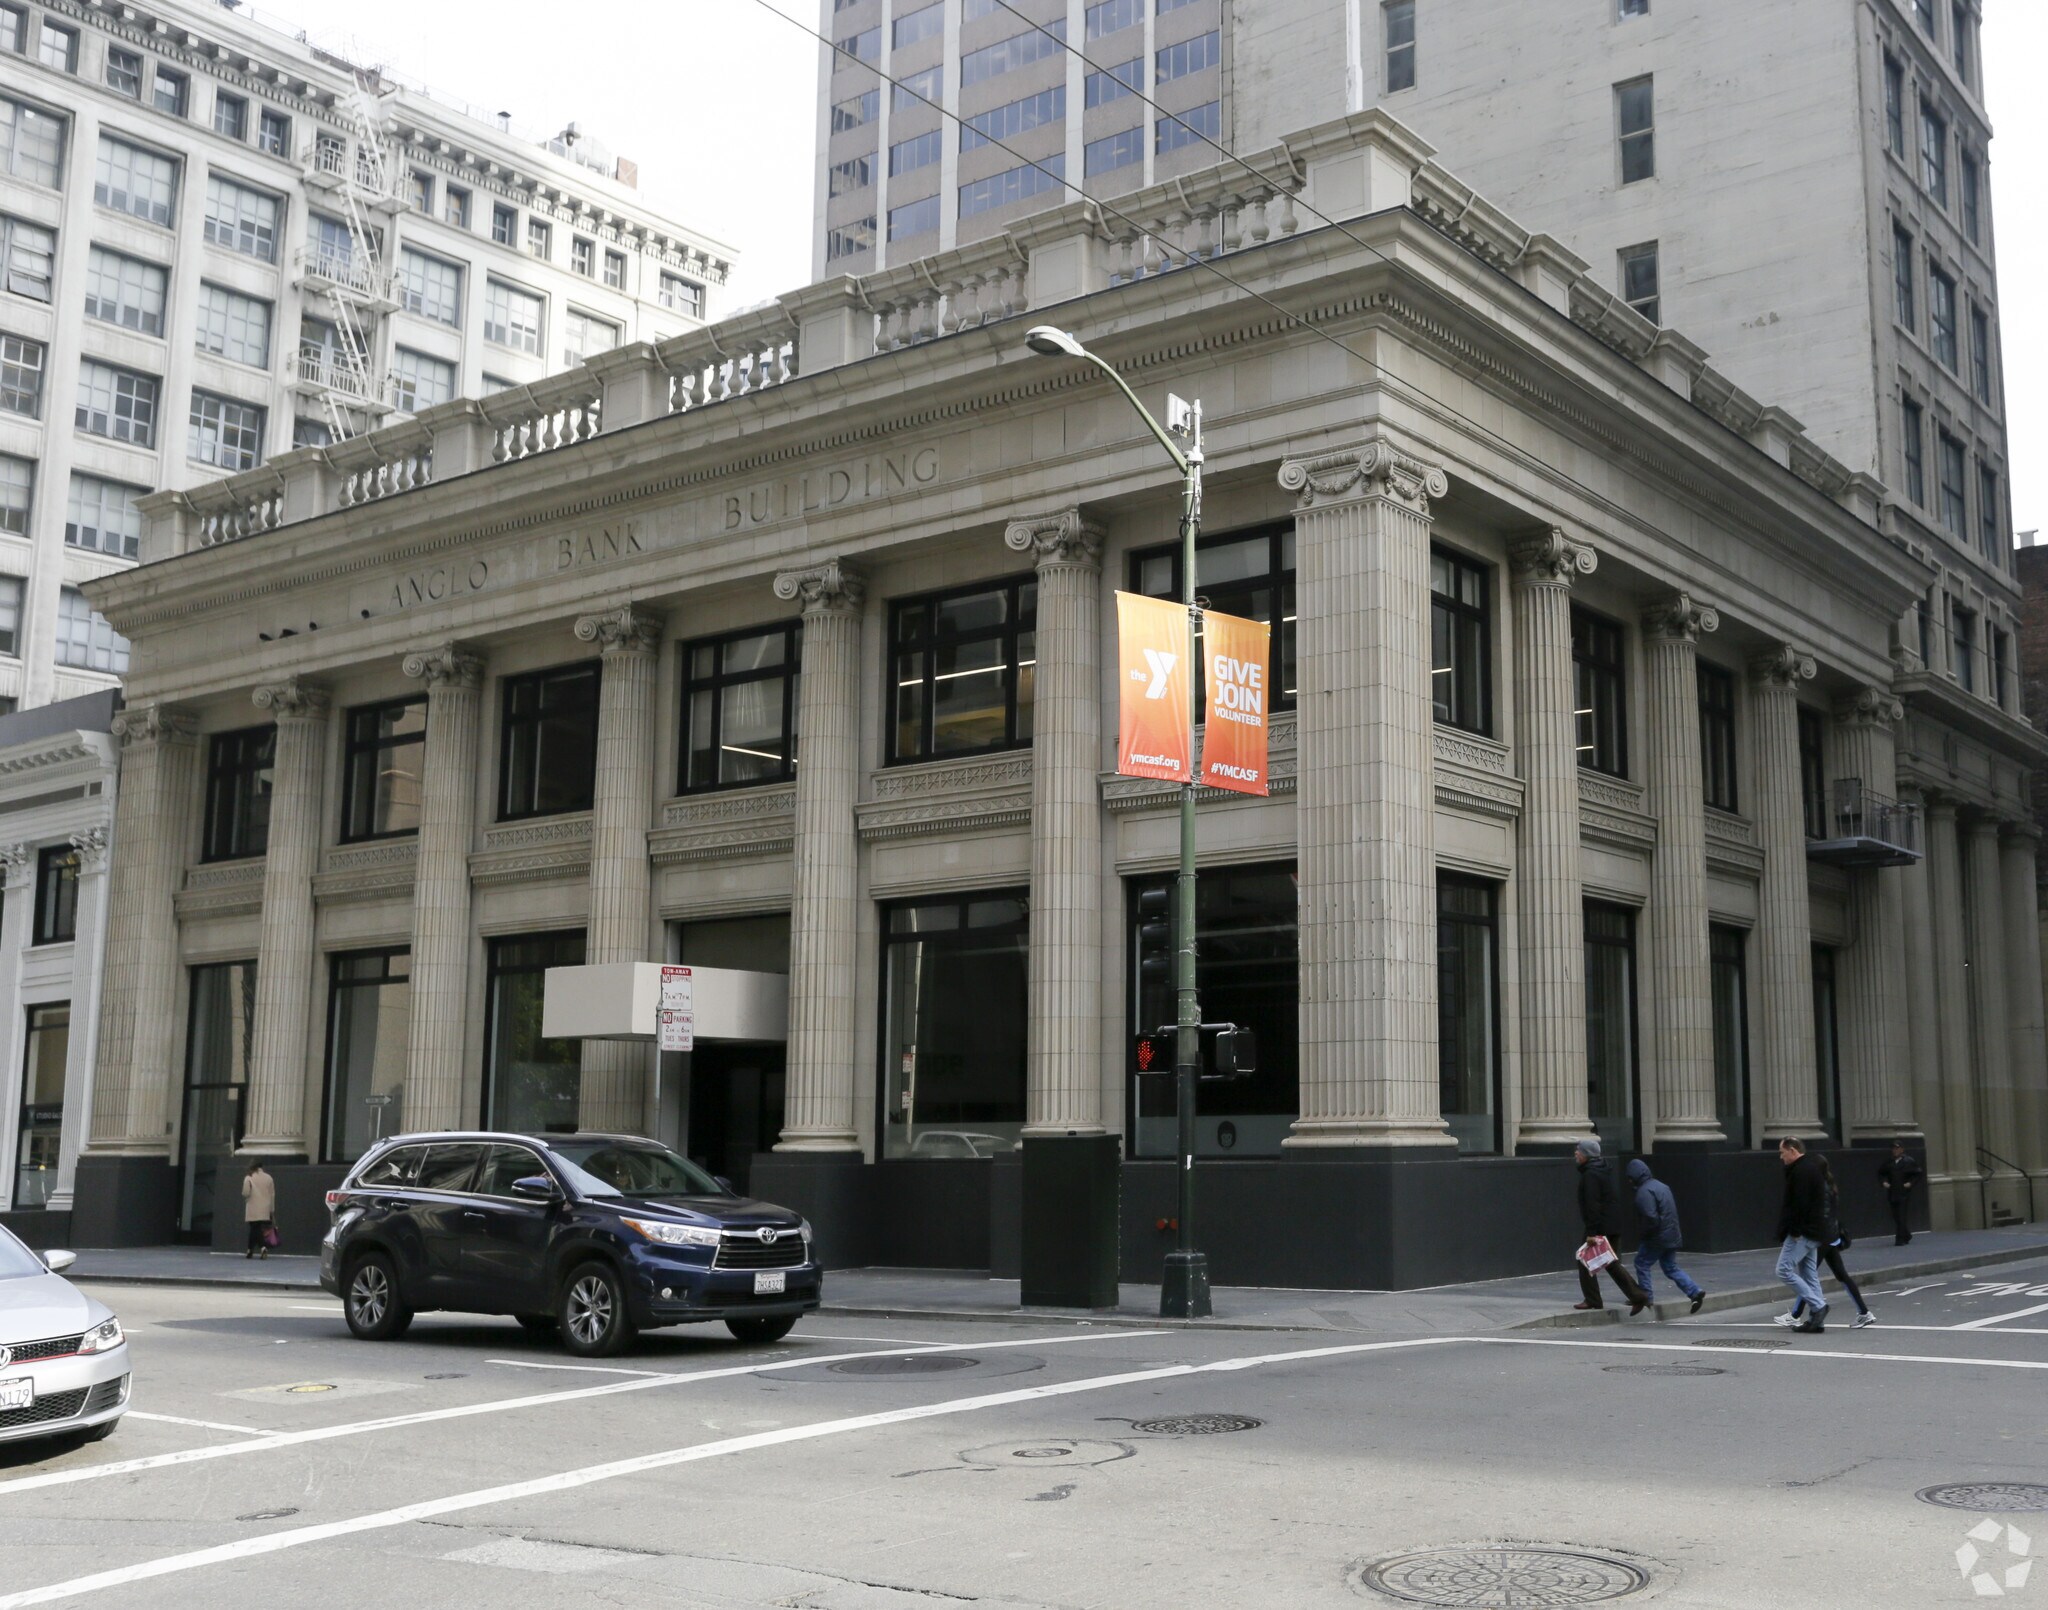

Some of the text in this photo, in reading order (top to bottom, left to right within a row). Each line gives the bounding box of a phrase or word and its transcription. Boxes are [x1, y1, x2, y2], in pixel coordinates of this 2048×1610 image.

[390, 447, 938, 611] ANGLO BANK BUILDING
[1130, 668, 1146, 682] the
[1213, 654, 1262, 688] GIVE
[1213, 680, 1262, 715] JOIN
[1214, 706, 1262, 726] VOLUNTEER
[1130, 752, 1180, 771] ymcasf.org
[1210, 762, 1259, 782] #YMCASF
[662, 974, 671, 983] NO
[663, 1012, 692, 1024] NO PARKING
